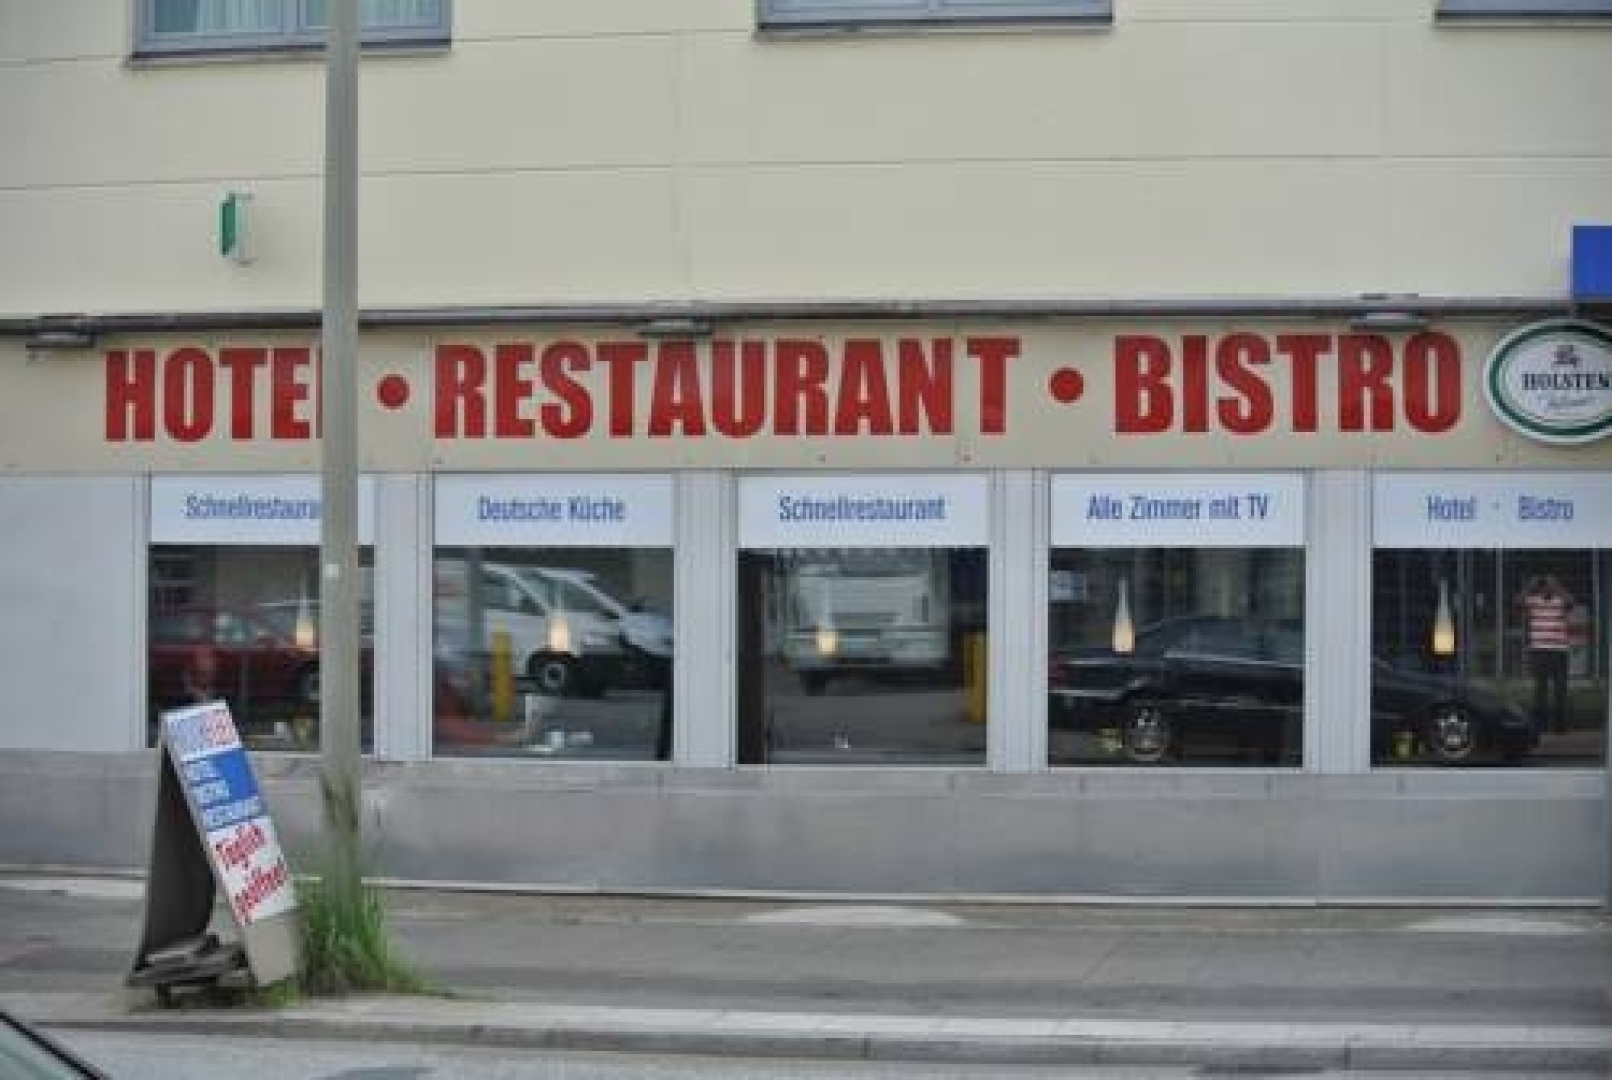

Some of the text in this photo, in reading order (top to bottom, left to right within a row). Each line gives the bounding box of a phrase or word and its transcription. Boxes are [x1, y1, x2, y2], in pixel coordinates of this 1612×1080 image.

[106, 333, 1462, 442] HOTE RESTAURANT BISTRO
[1522, 371, 1611, 391] HOLSTEN
[478, 494, 625, 522] Deutsche Küche
[779, 493, 946, 521] Schnellrestaurant
[1086, 492, 1270, 520] Alle Zimmer mit TV
[1427, 494, 1574, 522] Hotel Bistro
